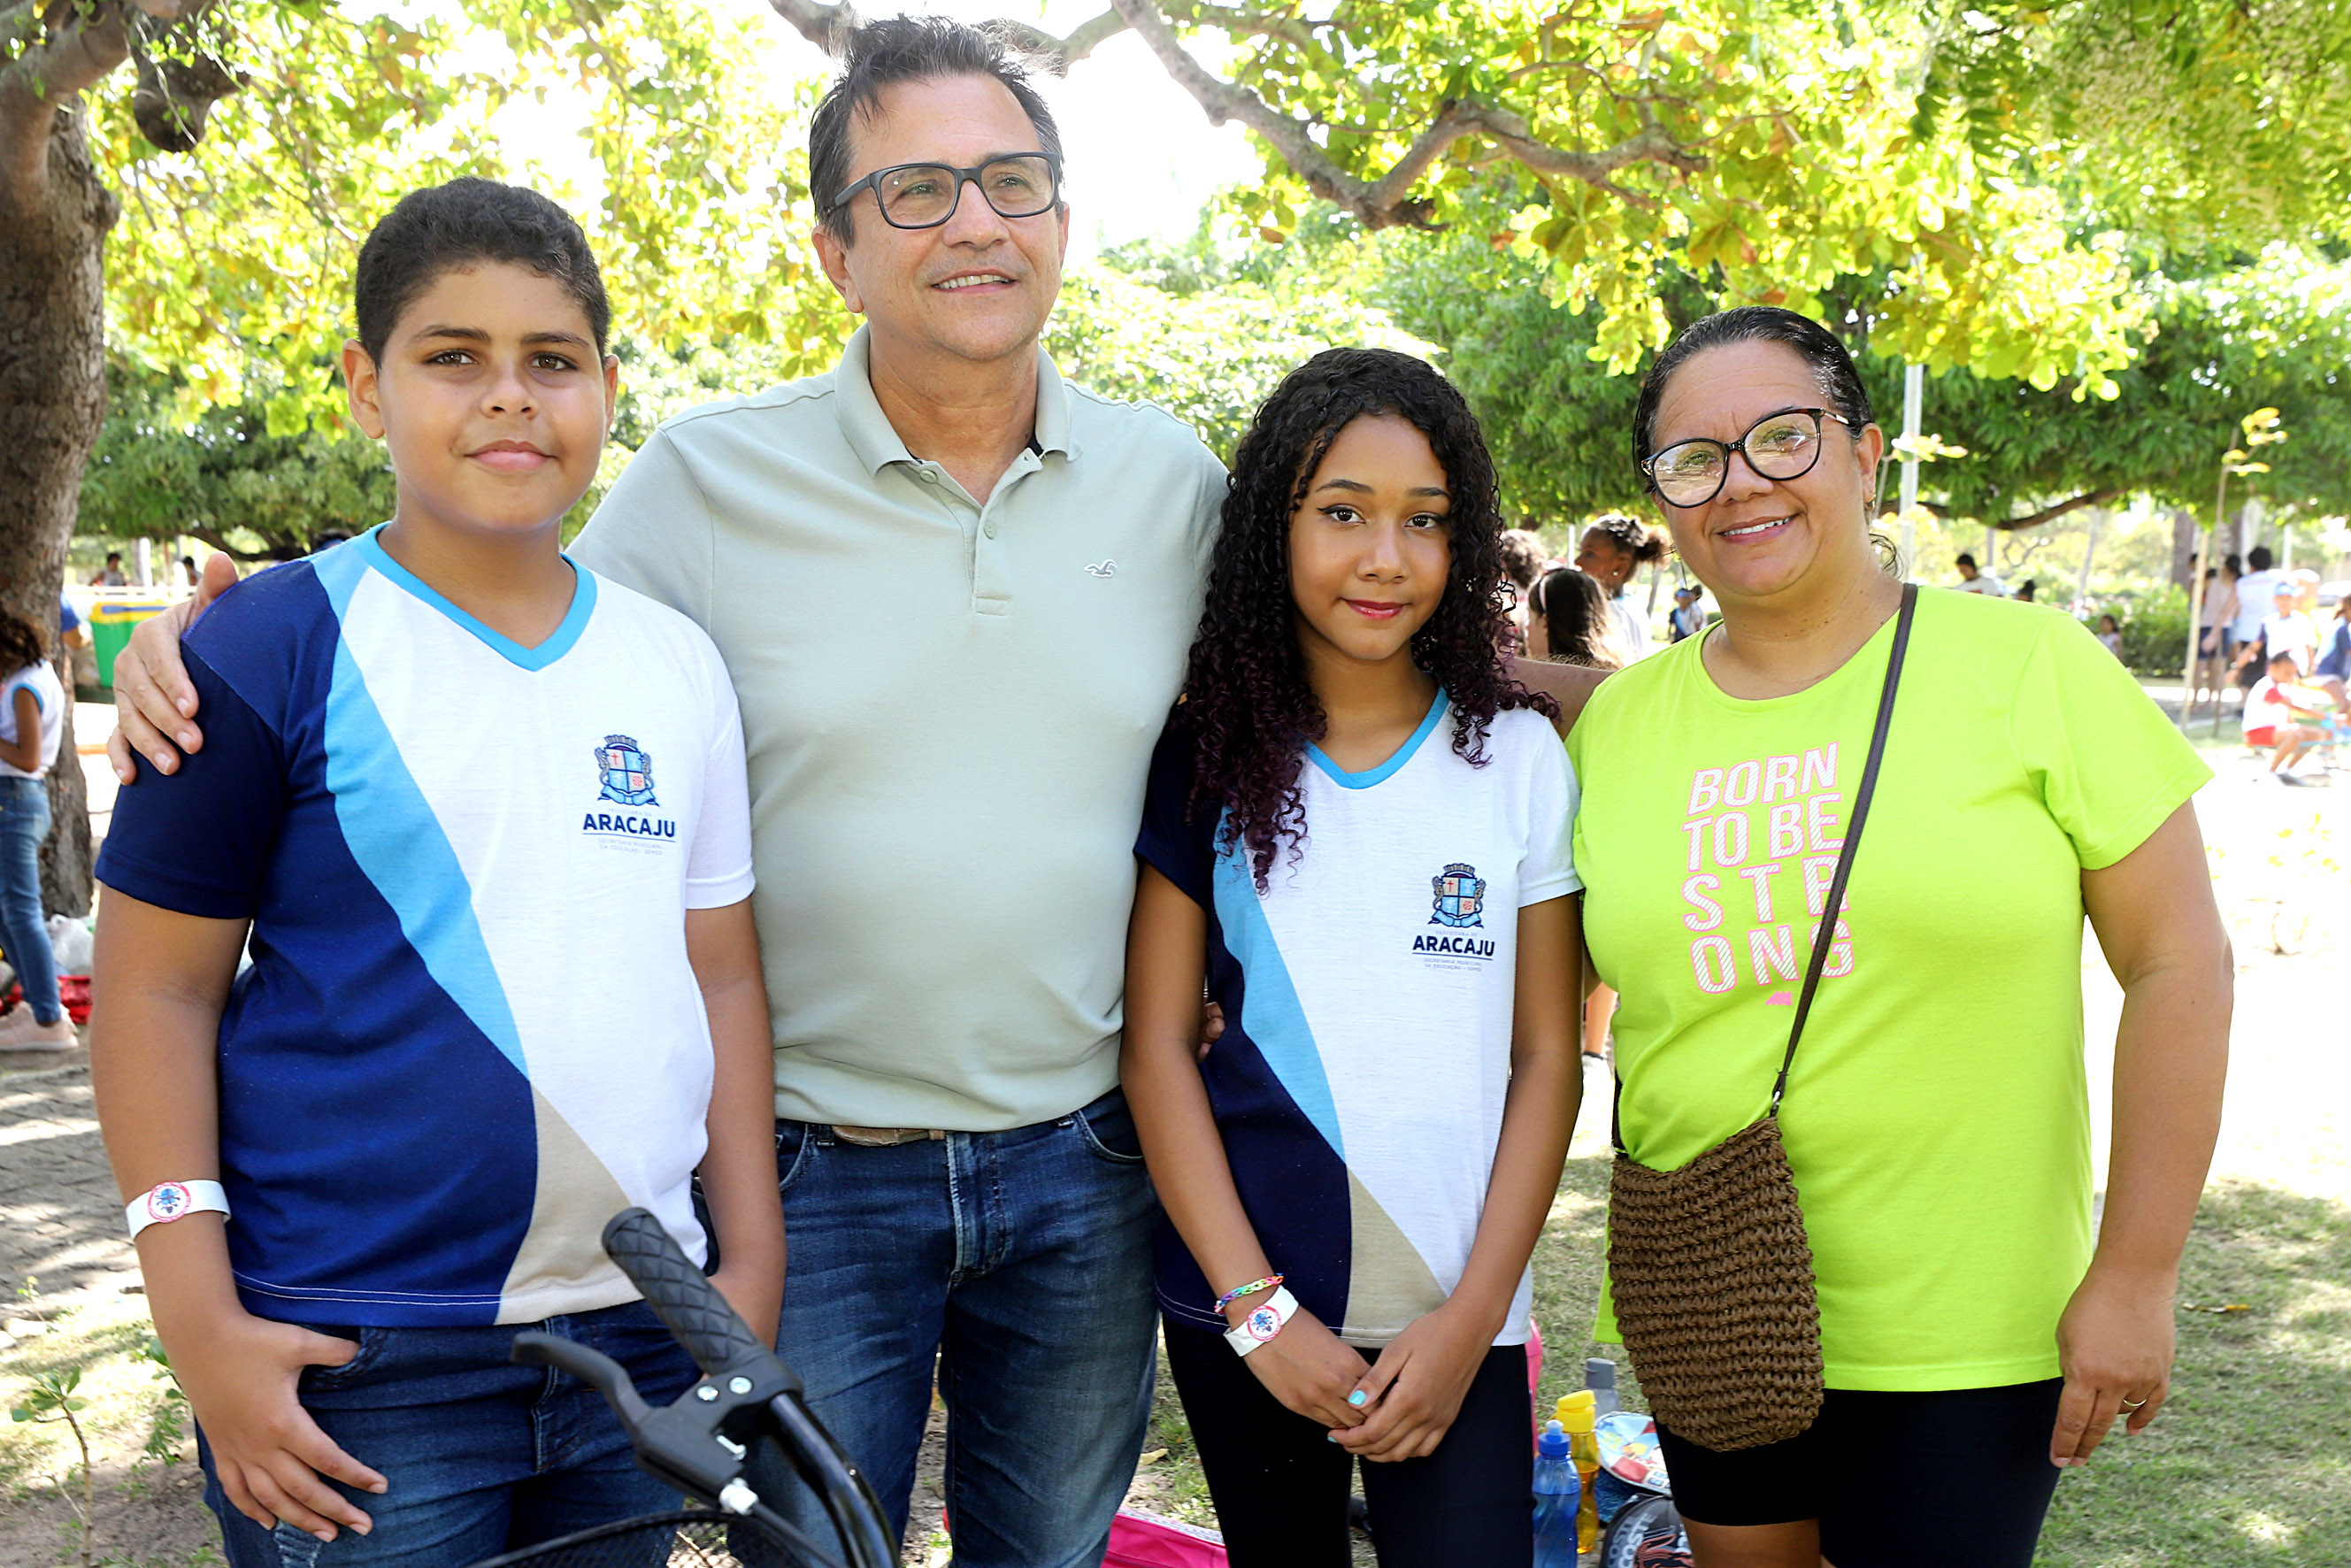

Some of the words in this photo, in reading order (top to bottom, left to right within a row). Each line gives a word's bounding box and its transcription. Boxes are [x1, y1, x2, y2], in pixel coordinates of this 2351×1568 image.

[1686, 741, 1840, 816] BORN
[582, 813, 675, 838] ARACAJU
[1681, 811, 1749, 872] TO
[1769, 792, 1847, 860] BE
[1412, 935, 1495, 957] ARACAJU
